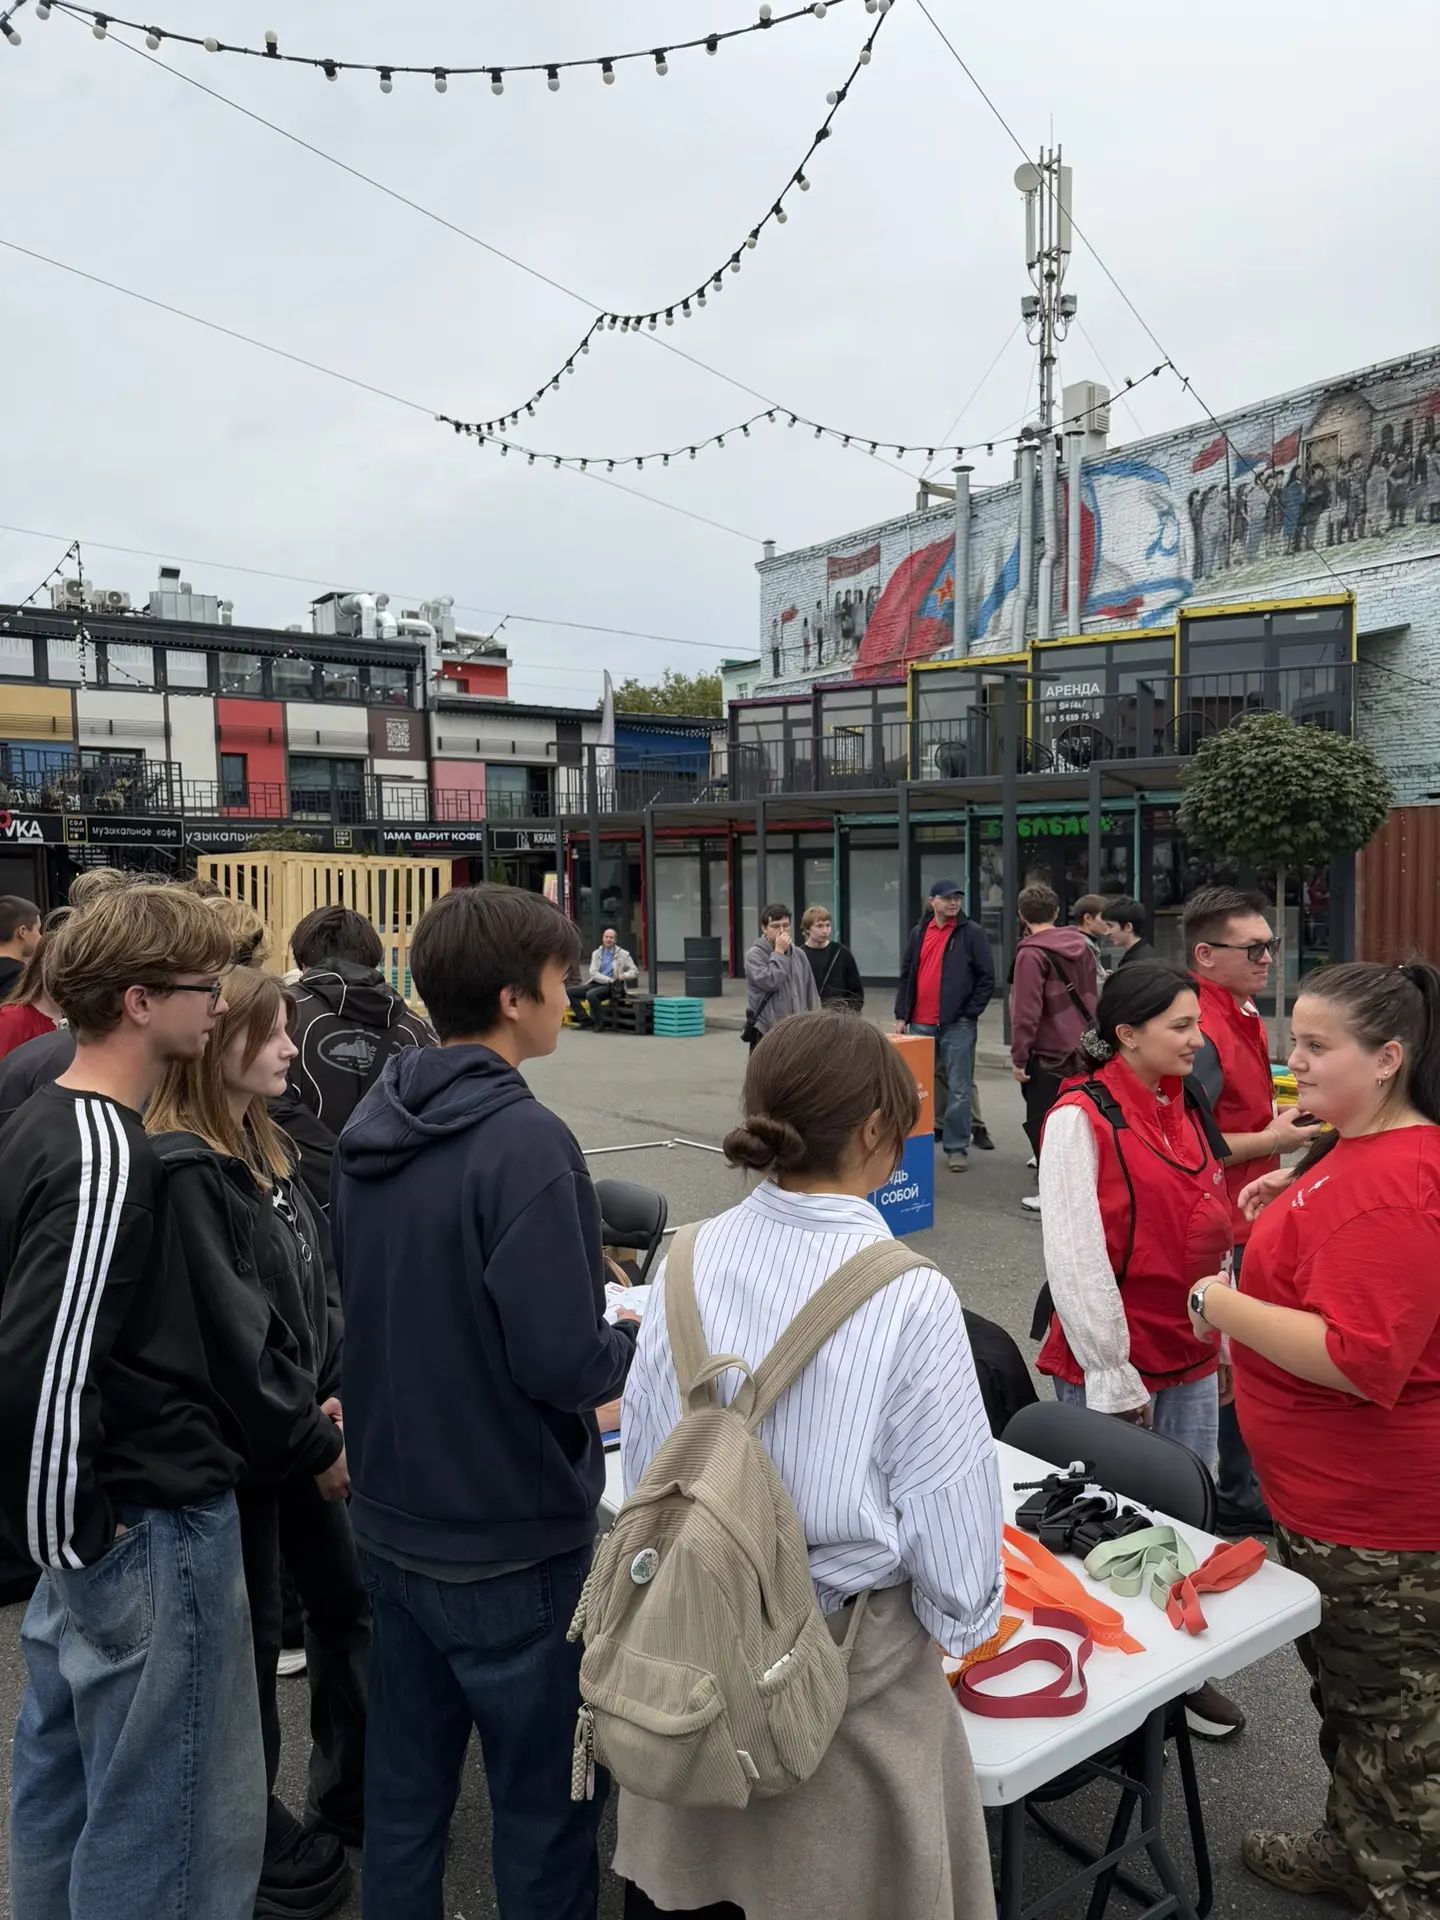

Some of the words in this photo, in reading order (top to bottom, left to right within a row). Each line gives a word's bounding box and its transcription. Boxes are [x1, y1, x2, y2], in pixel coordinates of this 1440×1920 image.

[1046, 683, 1100, 697] АРЕНДА
[0, 820, 43, 837] VKA
[92, 826, 152, 837] музыкальное
[156, 828, 177, 838] кафе
[415, 832, 450, 841] ВАРИТ
[452, 832, 482, 841] КОФЕ
[889, 1168, 909, 1185] ДЬ
[881, 1183, 919, 1205] СОБОЙ
